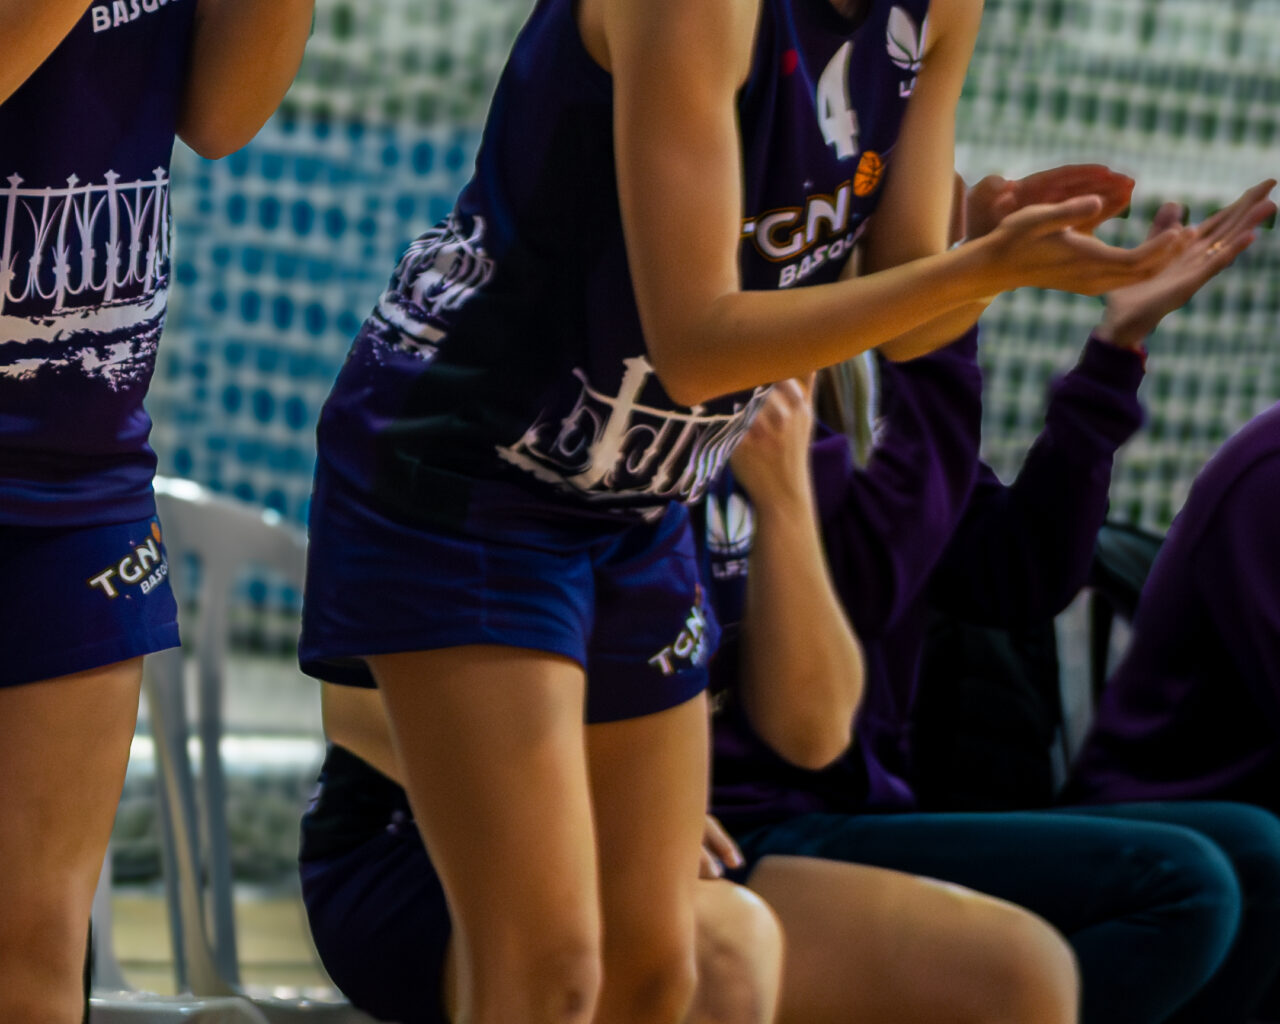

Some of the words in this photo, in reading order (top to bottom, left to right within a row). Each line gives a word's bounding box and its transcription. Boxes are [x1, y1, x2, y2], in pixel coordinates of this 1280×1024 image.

[816, 39, 859, 161] 4
[741, 181, 852, 260] GN
[89, 537, 160, 598] TGN
